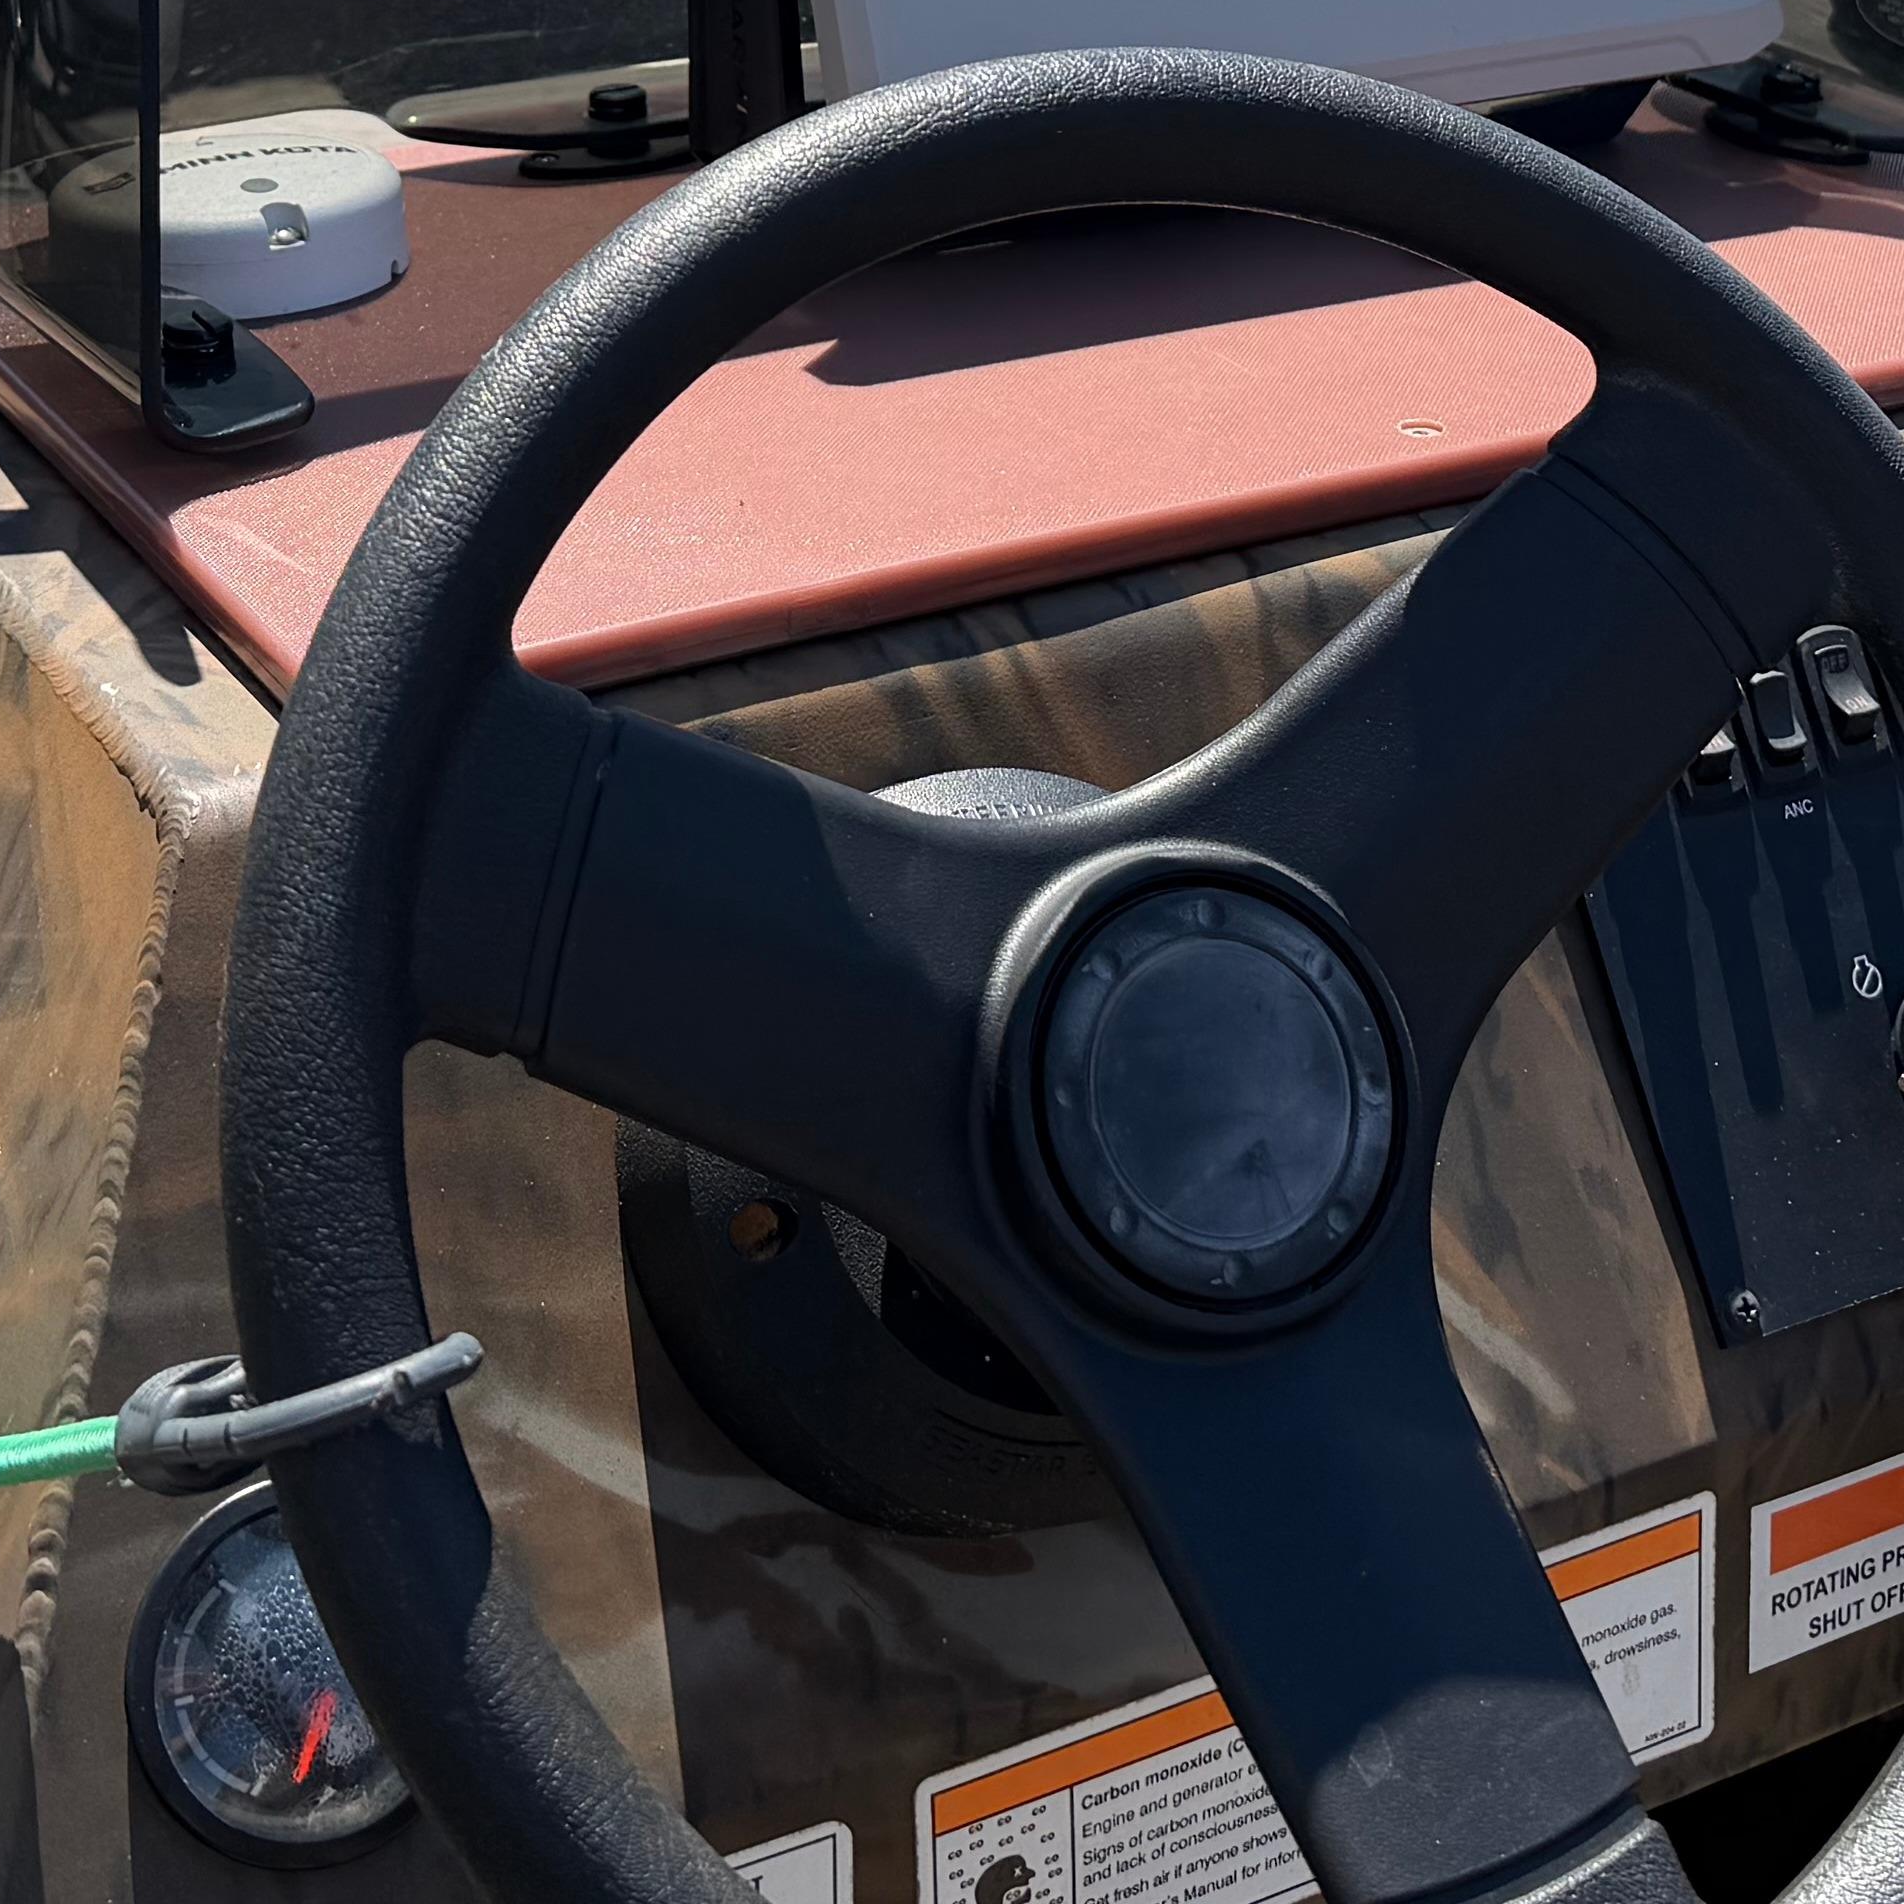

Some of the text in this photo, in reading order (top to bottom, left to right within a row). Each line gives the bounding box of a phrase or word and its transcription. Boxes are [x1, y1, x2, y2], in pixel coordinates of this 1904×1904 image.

[160, 145, 359, 175] MINN KOTA
[1822, 653, 1848, 674] OFF
[1845, 695, 1869, 710] ON
[1784, 798, 1815, 820] ANC
[1771, 1558, 1876, 1617] ROTATING
[1581, 1603, 1678, 1648] monoxide gas.
[1809, 1598, 1865, 1639] SHUT
[1604, 1628, 1681, 1665] drowsiness,
[1081, 1779, 1140, 1811] Carbon
[1145, 1747, 1222, 1788] monoxide
[1081, 1808, 1136, 1839] Engine
[1140, 1794, 1168, 1817] and
[1172, 1766, 1244, 1808] generator
[1083, 1841, 1125, 1866] Signs
[1128, 1829, 1143, 1848] of
[1146, 1811, 1198, 1842] carbon
[1083, 1803, 1278, 1887] and lack of consciousness
[1113, 1878, 1149, 1902] fresh
[1153, 1869, 1170, 1887] air
[1174, 1863, 1183, 1879] if
[1186, 1845, 1239, 1874] anyone
[1242, 1827, 1287, 1853] shows
[1183, 1848, 1302, 1902] Manual for infor
